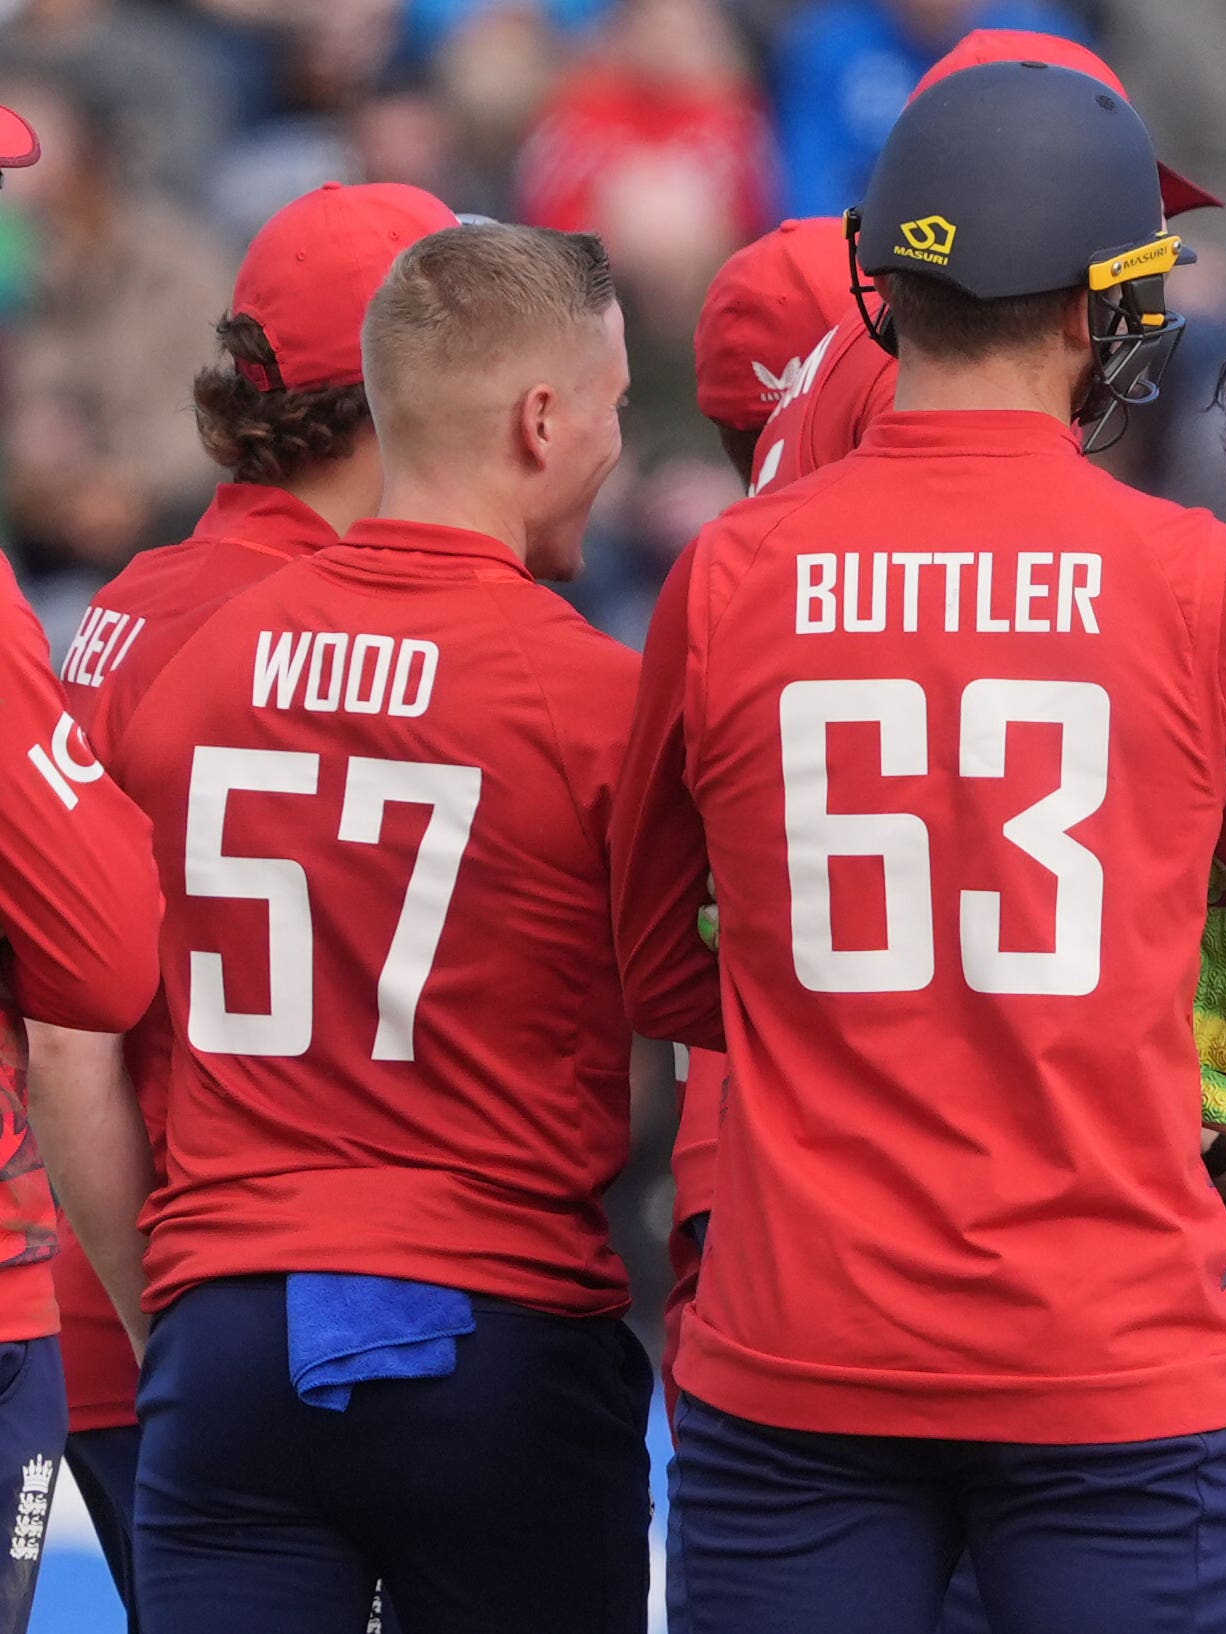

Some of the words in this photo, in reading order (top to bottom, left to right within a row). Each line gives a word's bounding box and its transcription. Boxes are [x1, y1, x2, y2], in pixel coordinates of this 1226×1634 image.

[893, 245, 949, 266] MASURI
[1123, 246, 1168, 269] MASURI
[795, 551, 1103, 635] BUTTLER
[252, 630, 439, 718] WOOD
[779, 678, 1111, 997] 63
[185, 745, 482, 1062] 57
